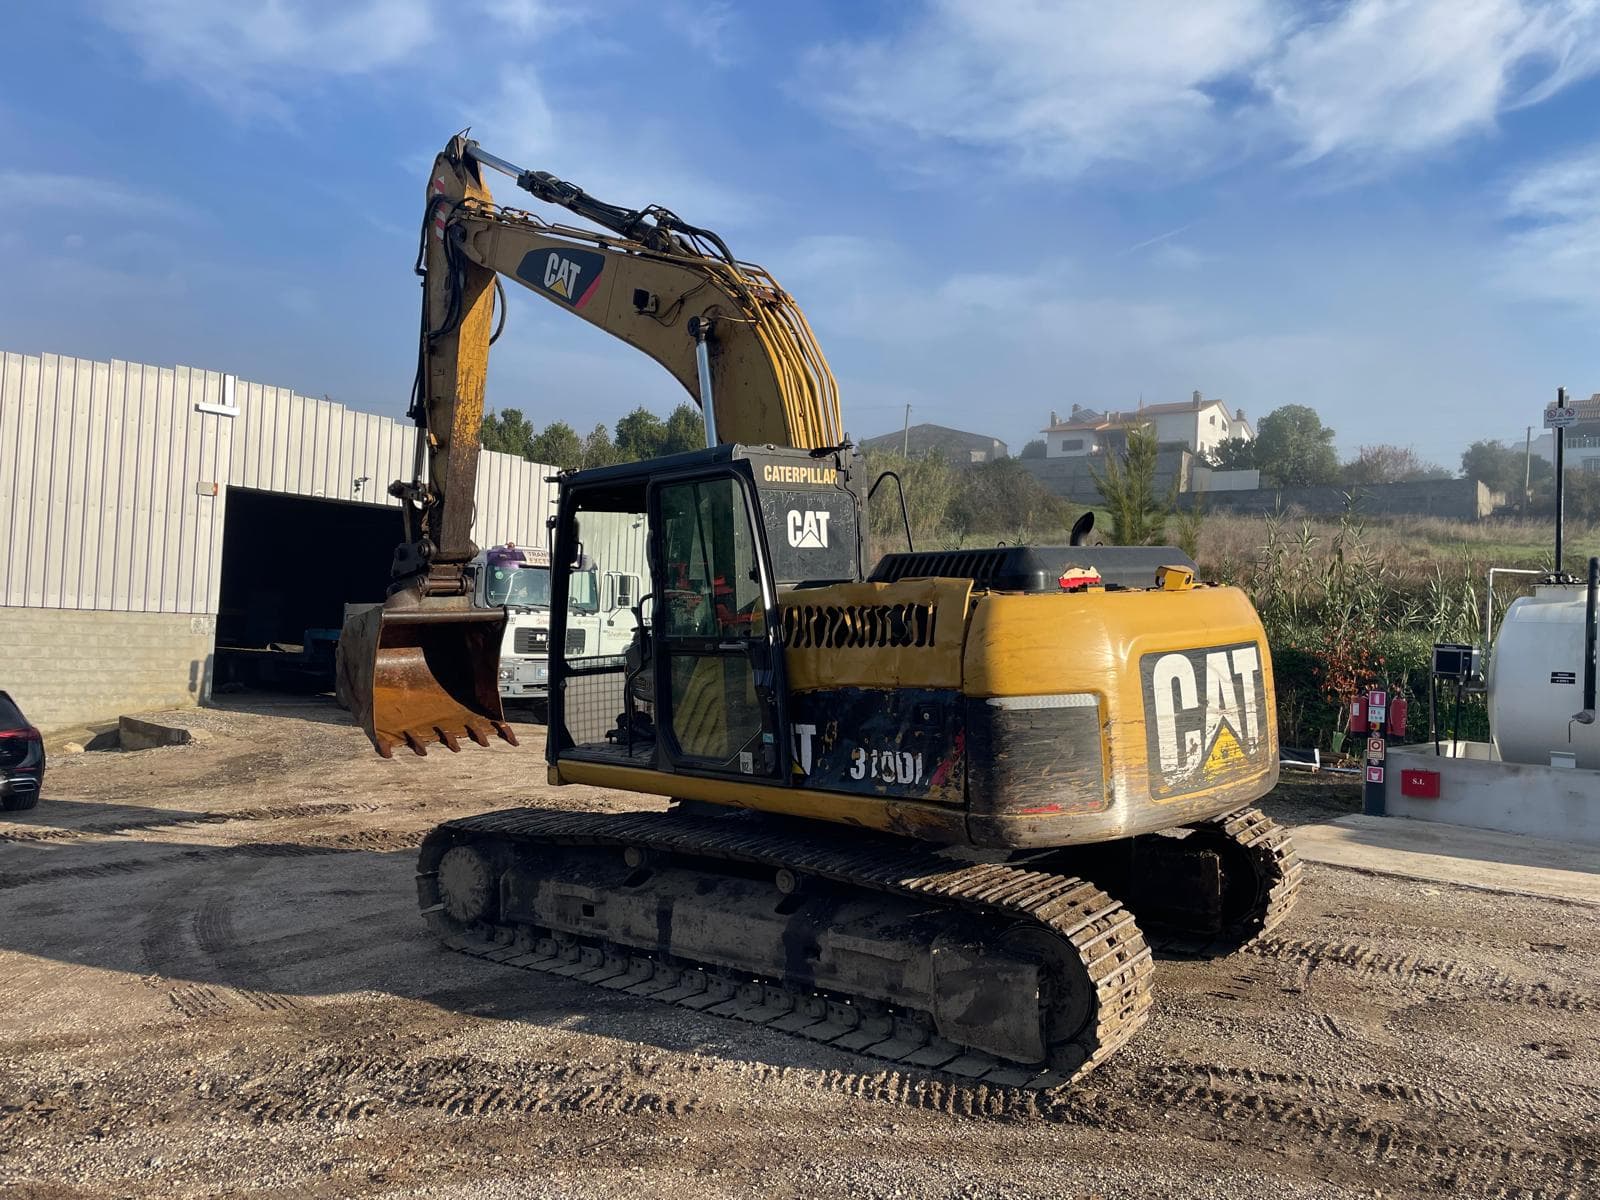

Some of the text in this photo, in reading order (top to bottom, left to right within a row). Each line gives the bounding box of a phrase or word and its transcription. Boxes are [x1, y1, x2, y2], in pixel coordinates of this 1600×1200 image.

[543, 252, 582, 300] CAT
[763, 464, 838, 485] CATERPILLAR
[787, 509, 830, 548] CAT
[1153, 647, 1260, 787] CAT
